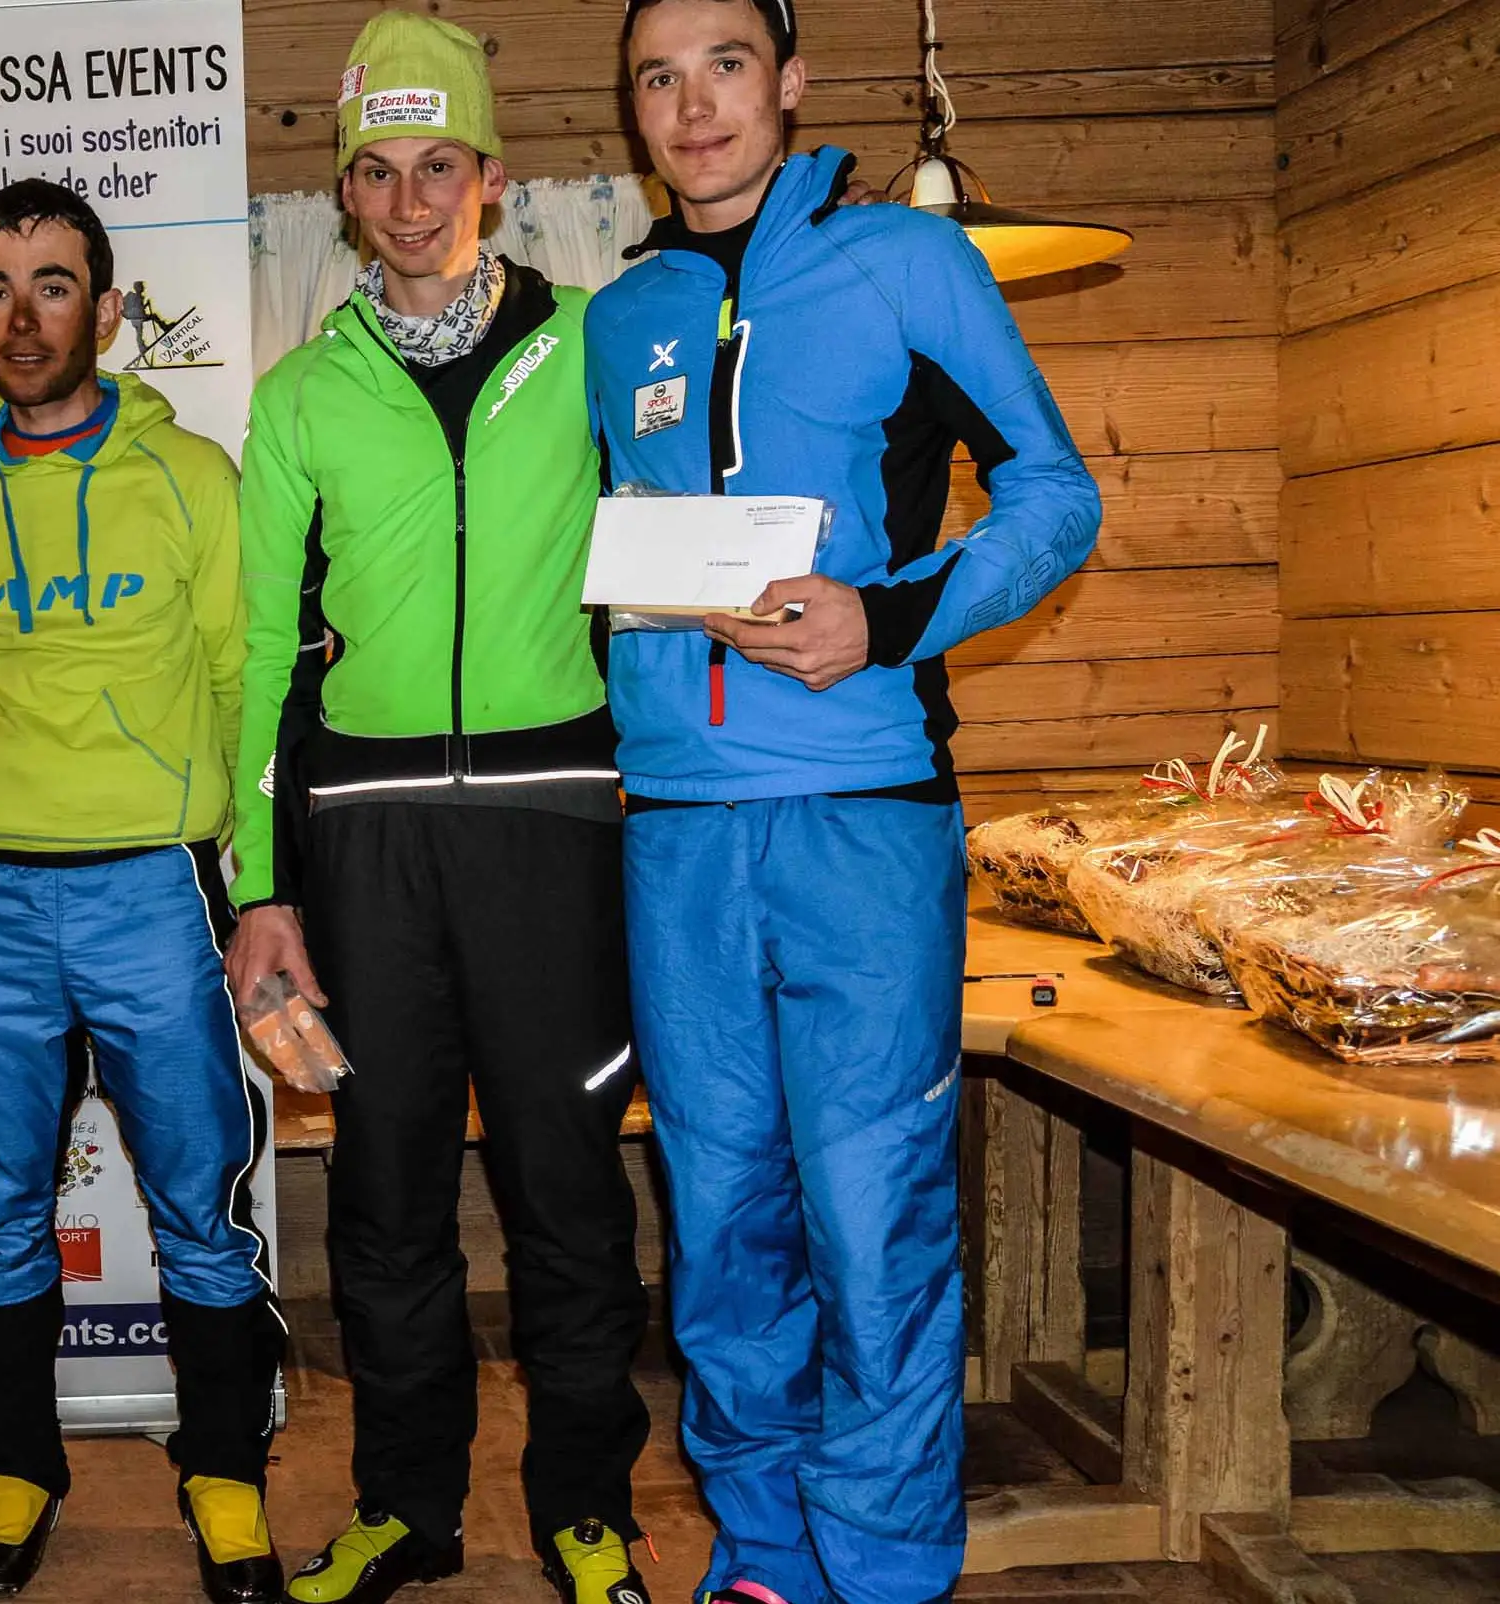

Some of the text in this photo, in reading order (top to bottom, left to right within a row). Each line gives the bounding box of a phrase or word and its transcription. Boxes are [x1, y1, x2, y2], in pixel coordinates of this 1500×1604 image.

[85, 44, 228, 99] EVENTS
[380, 93, 429, 108] Zorzi Max
[3, 129, 11, 157] i
[21, 125, 73, 156] suoi
[82, 116, 222, 153] sostenitori
[59, 166, 89, 200] de
[98, 162, 158, 199] cher
[160, 315, 204, 349] VERTICAL
[182, 340, 212, 362] VENT
[57, 1231, 90, 1243] ORT
